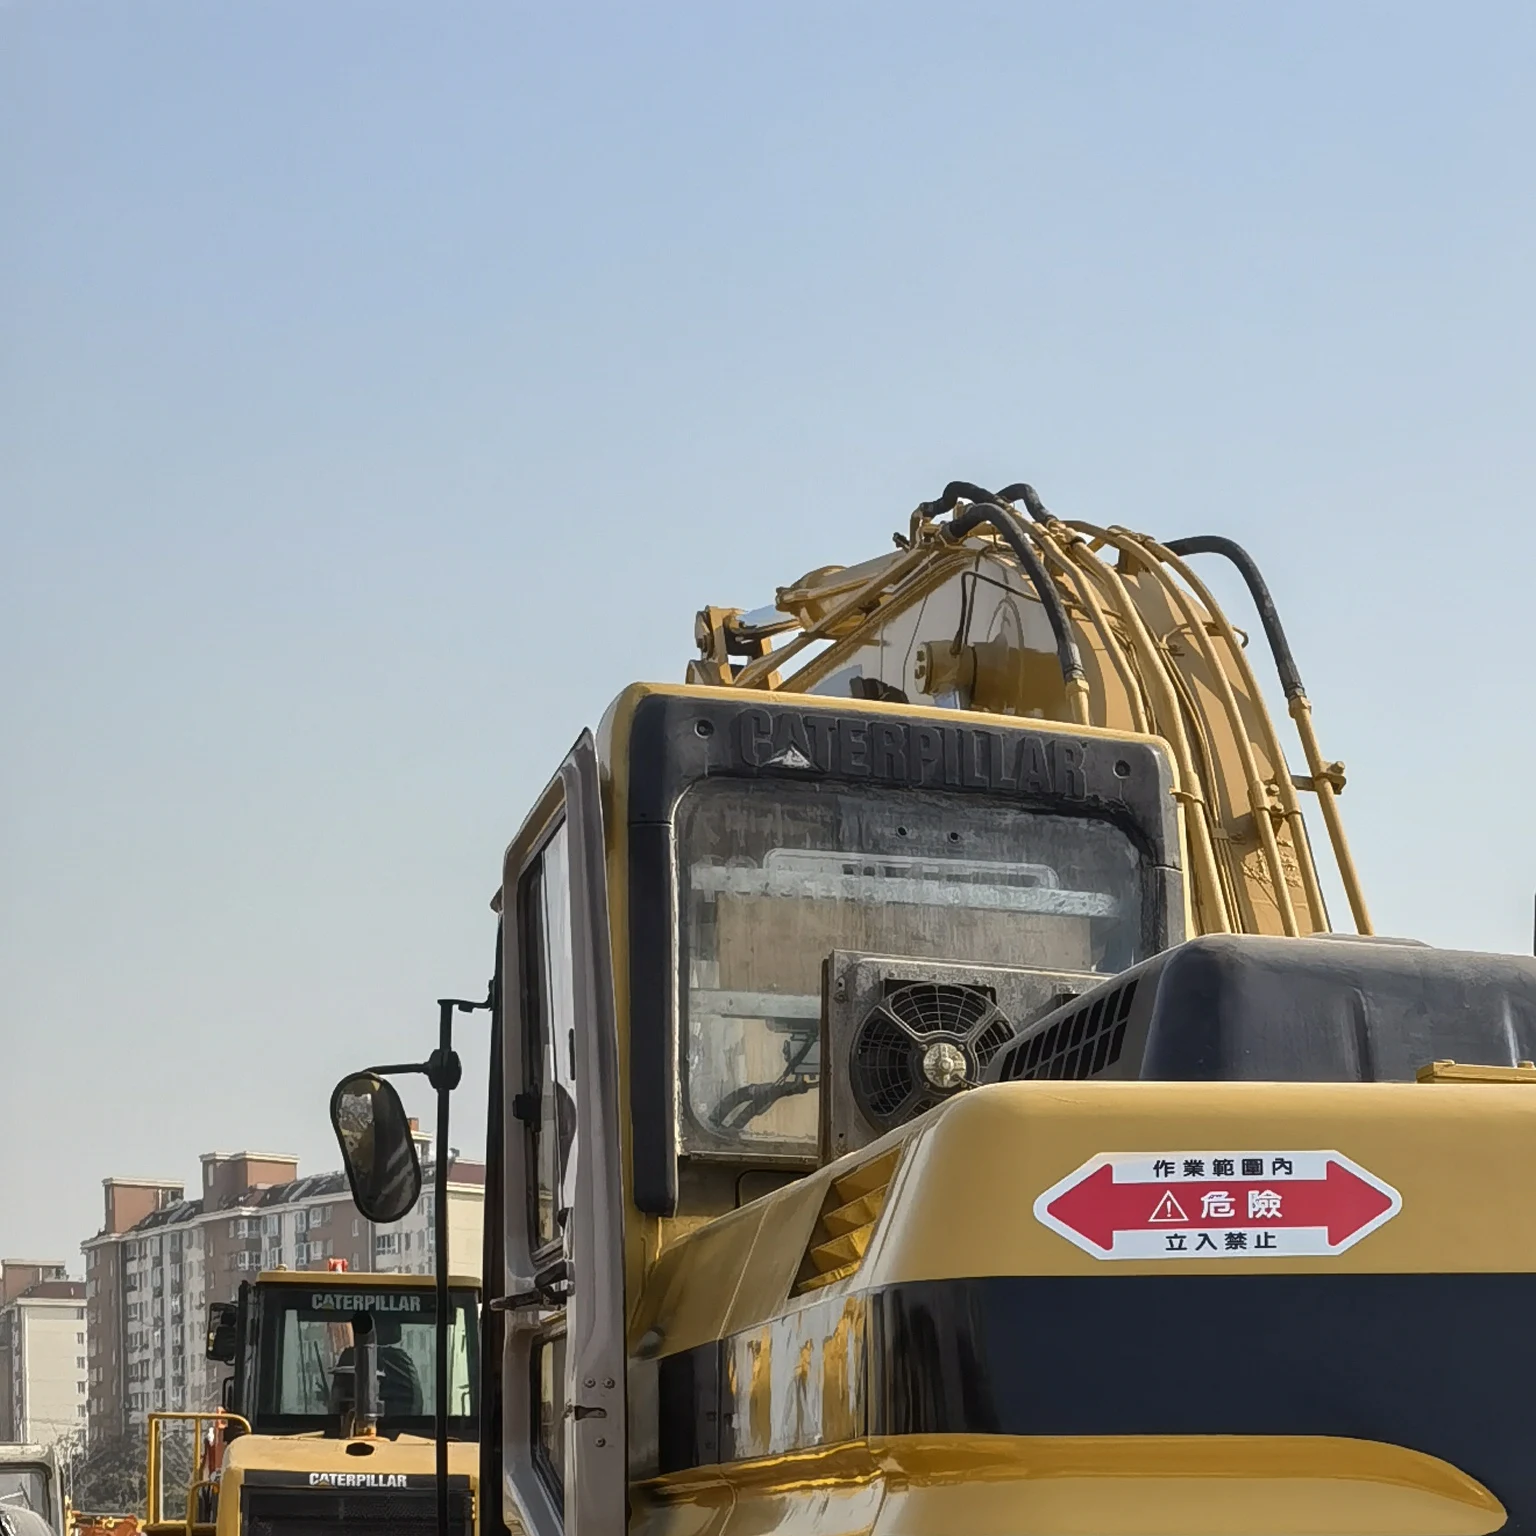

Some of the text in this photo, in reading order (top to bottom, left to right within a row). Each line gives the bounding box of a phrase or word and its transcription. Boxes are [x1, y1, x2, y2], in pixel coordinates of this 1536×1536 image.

[738, 708, 1088, 799] CATERPILLAR
[1200, 1190, 1284, 1220] 危險
[1165, 1231, 1279, 1251] 立入禁止
[311, 1293, 421, 1312] CATERPILLAR
[309, 1472, 408, 1488] CATERPILLAR
